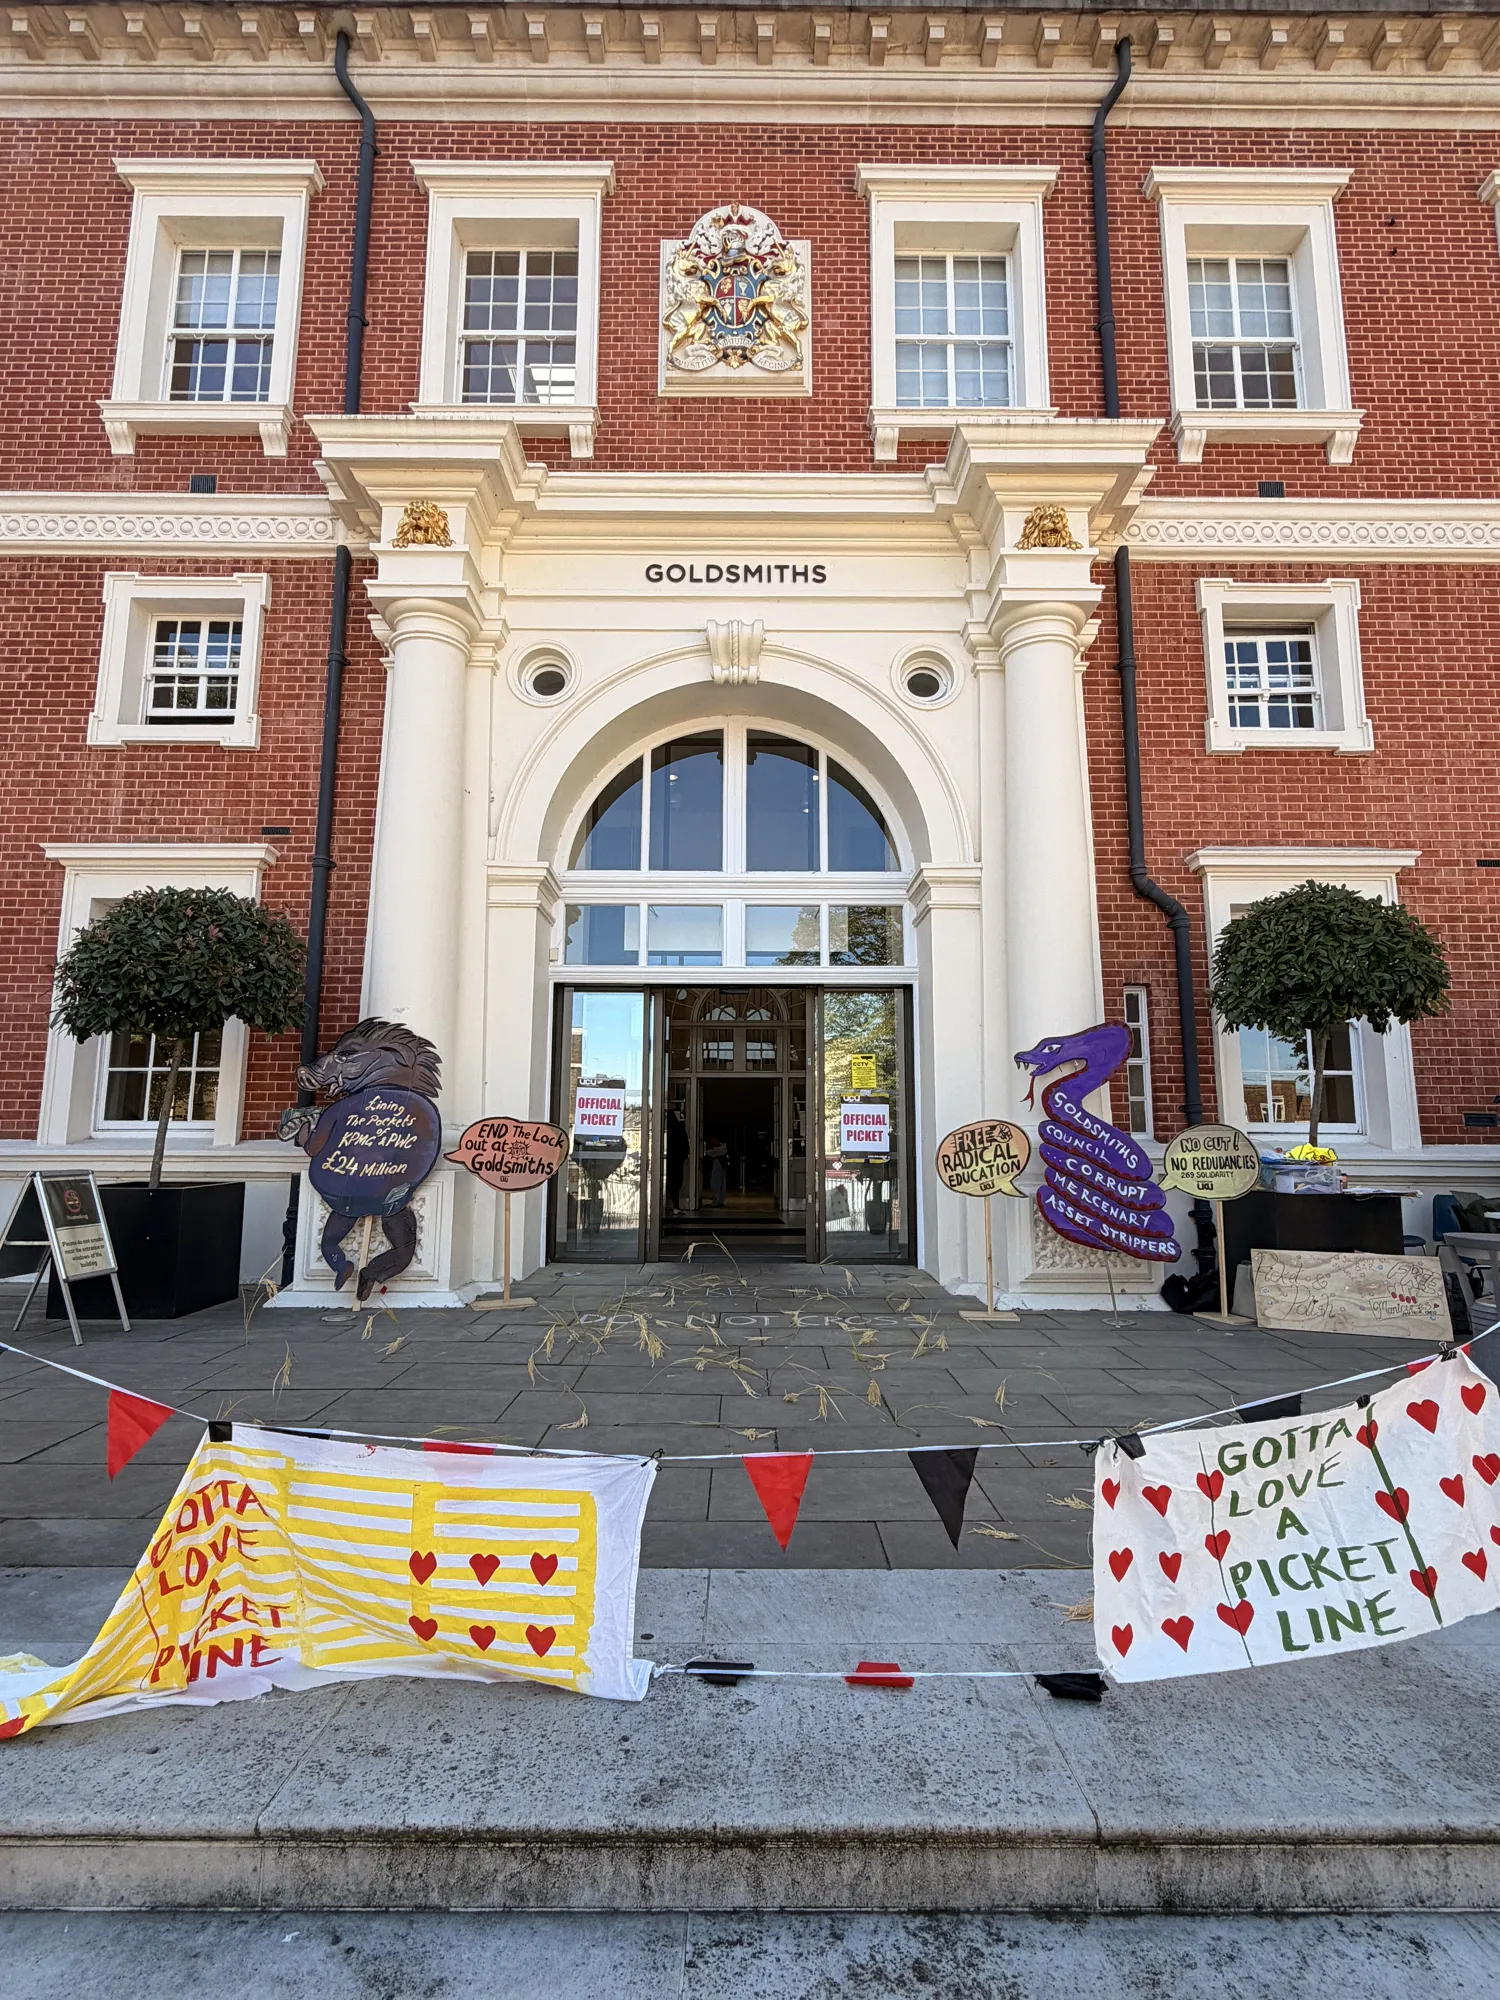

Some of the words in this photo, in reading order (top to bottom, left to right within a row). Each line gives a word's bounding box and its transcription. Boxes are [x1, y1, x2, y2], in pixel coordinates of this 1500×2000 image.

[645, 563, 827, 584] GOLDSMITHS
[577, 1097, 621, 1110] OFFICIAL
[346, 1114, 366, 1127] The
[366, 1114, 417, 1128] Pockets
[376, 1127, 391, 1138] of
[580, 1113, 618, 1126] PICKET
[843, 1113, 887, 1126] OFFICIAL
[1053, 1091, 1139, 1169] GOLDSMITHS
[338, 1131, 377, 1148] KPMG
[465, 1138, 489, 1152] out
[491, 1139, 509, 1153] at
[478, 1123, 509, 1139] END
[512, 1125, 531, 1139] The
[532, 1126, 565, 1149] Lock
[846, 1130, 884, 1142] PICKET
[954, 1126, 993, 1152] FREE
[1045, 1124, 1112, 1165] COUNCIL
[1181, 1137, 1201, 1153] NO
[321, 1150, 358, 1176] £24
[359, 1161, 408, 1177] Million
[471, 1153, 554, 1175] Goldsmiths
[942, 1143, 1018, 1173] RADICAL
[1171, 1157, 1188, 1171] NO
[1193, 1155, 1256, 1170] REDUDANCIES
[948, 1159, 1020, 1188] EDUCATION
[1181, 1171, 1195, 1179] 269
[1196, 1171, 1234, 1179] SOLIDARITY
[1054, 1172, 1152, 1229] MERCENARY
[1045, 1194, 1095, 1227] ASSET
[1100, 1224, 1177, 1255] STRIPPERS
[1254, 1251, 1304, 1286] Picket
[1387, 1262, 1442, 1294] FREE
[685, 1313, 779, 1327] NOT
[798, 1314, 932, 1327] CROSS
[1217, 1417, 1352, 1476] GOTTA
[1228, 1451, 1346, 1518] LOVE
[150, 1479, 270, 1569] GOTTA
[1276, 1507, 1309, 1541] A
[158, 1525, 260, 1597] LOVE
[1228, 1538, 1400, 1600] PICKET
[1276, 1589, 1407, 1653] LINE
